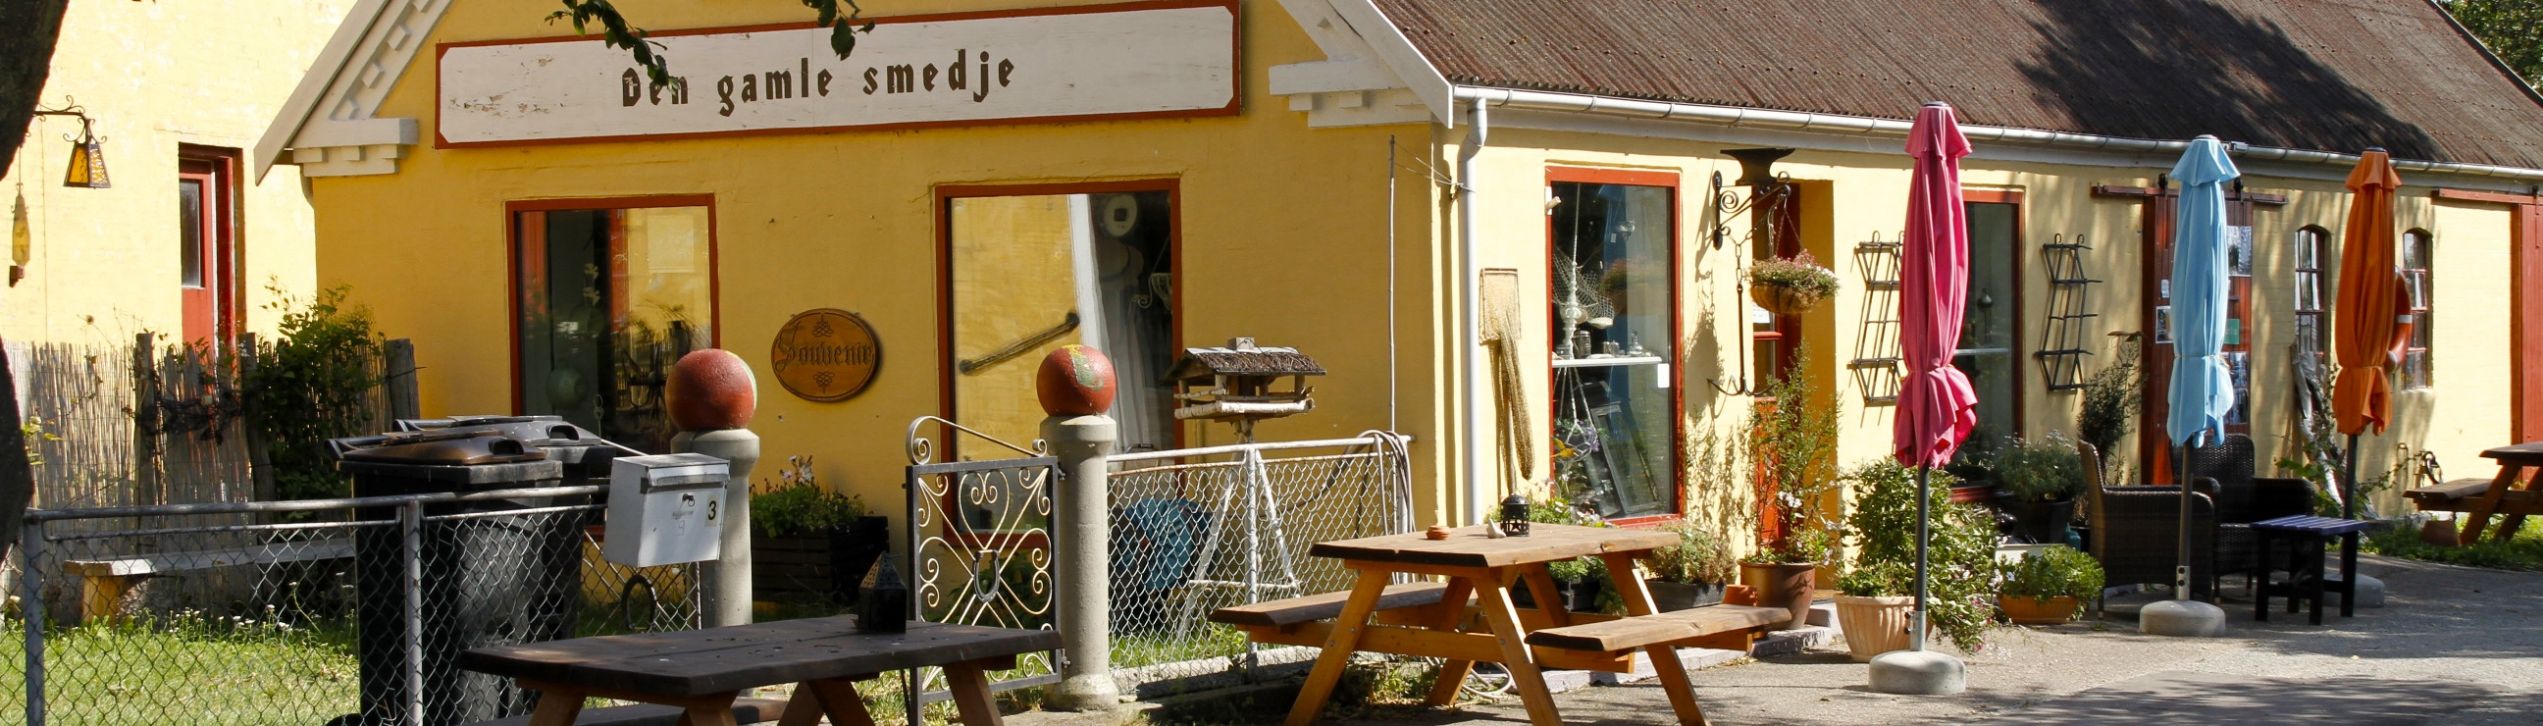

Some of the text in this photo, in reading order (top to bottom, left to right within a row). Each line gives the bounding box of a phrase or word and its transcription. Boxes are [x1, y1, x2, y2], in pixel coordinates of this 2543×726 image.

[622, 48, 1014, 117] Den gamle smedje
[775, 321, 873, 372] Souvenir
[707, 500, 717, 521] 3
